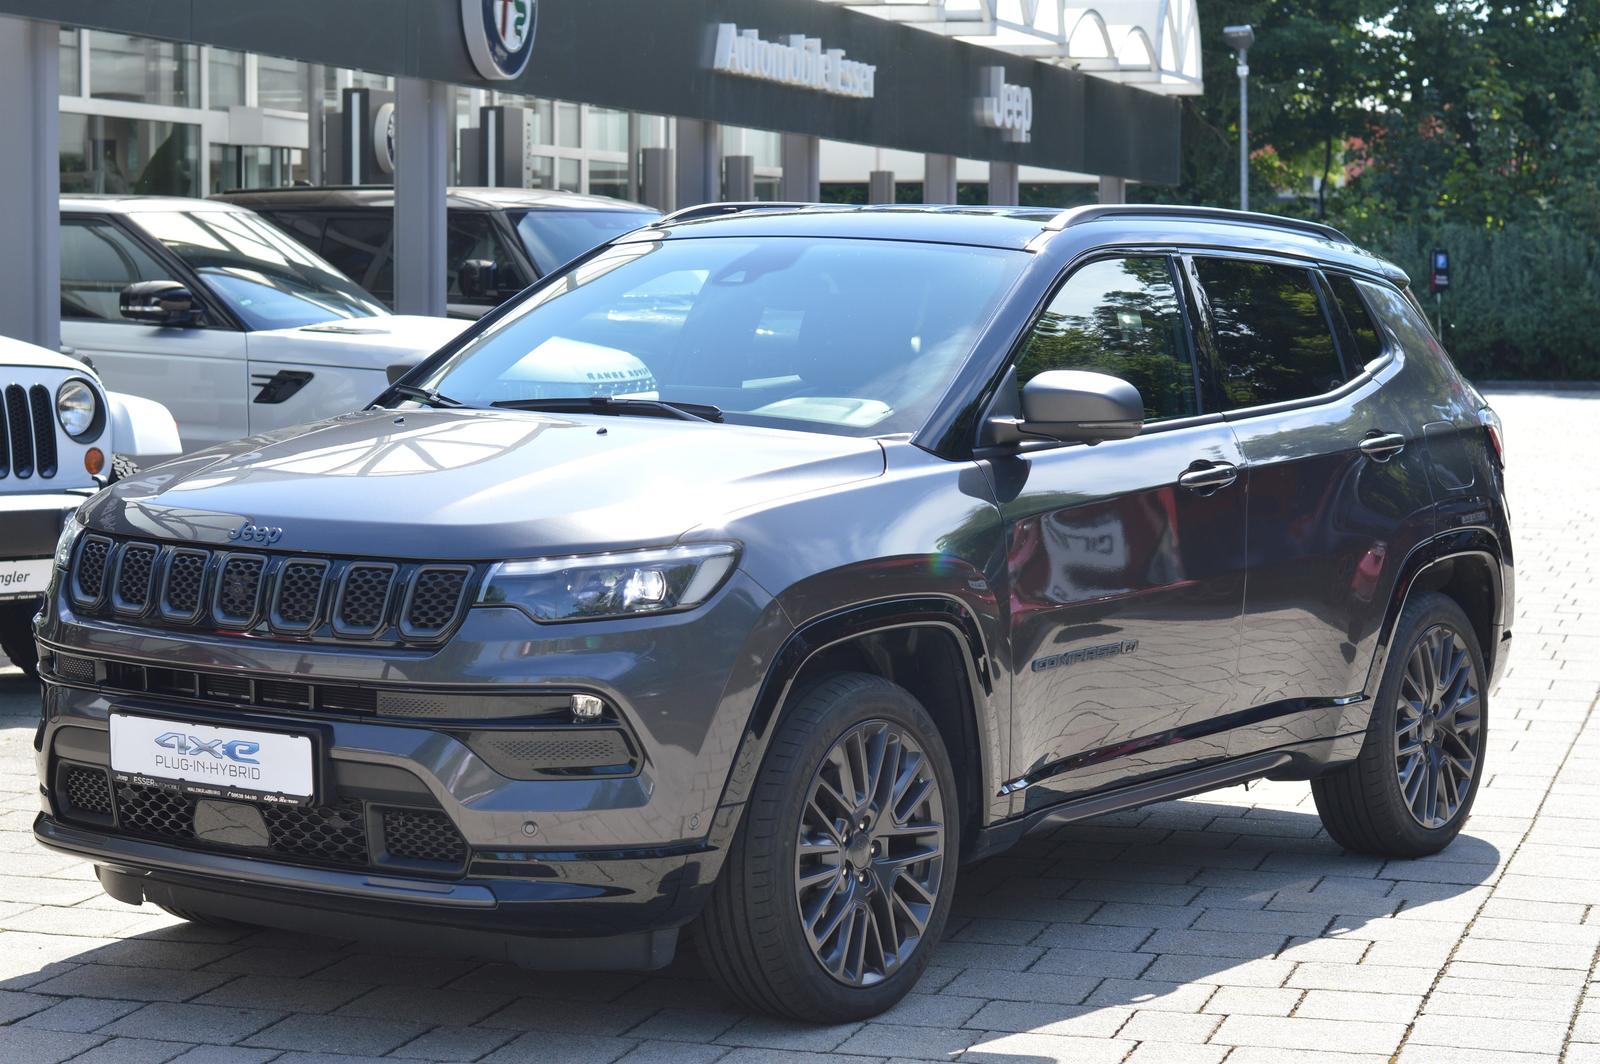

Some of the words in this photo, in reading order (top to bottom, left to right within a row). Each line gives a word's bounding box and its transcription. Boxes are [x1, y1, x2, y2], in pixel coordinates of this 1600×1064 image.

[713, 23, 831, 91] Automobile
[982, 66, 1032, 143] Jeep
[228, 520, 282, 546] Jeep
[1031, 642, 1121, 672] COMPASS
[133, 776, 155, 786] ESSER
[155, 755, 261, 780] PLUG-IN-HYBRID
